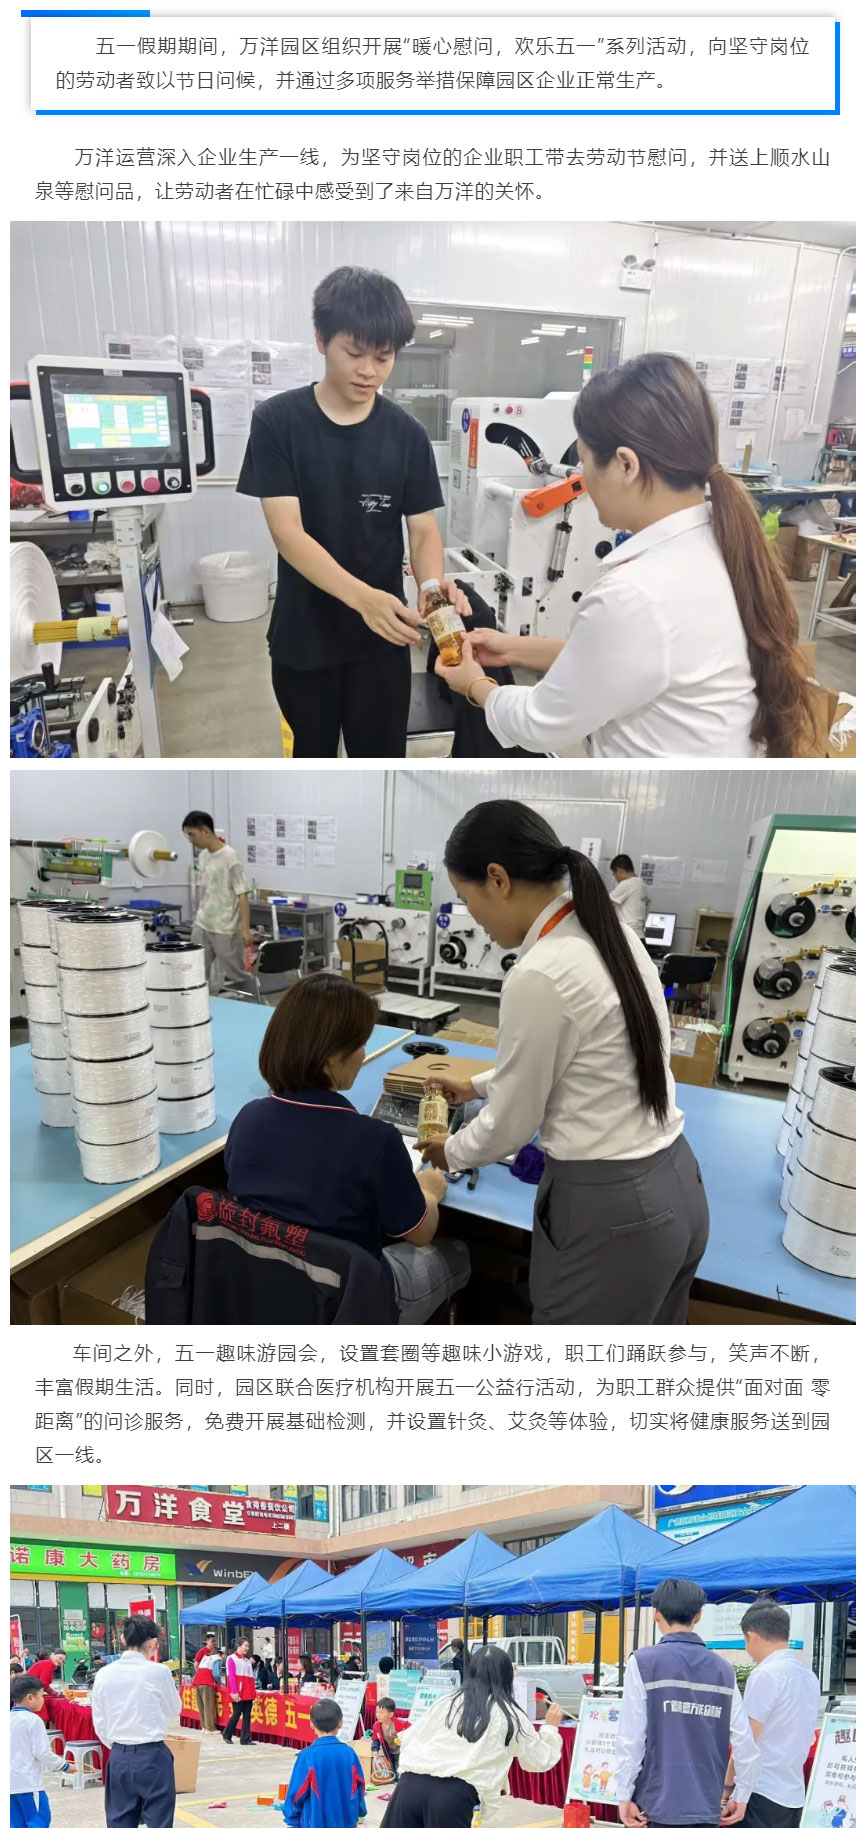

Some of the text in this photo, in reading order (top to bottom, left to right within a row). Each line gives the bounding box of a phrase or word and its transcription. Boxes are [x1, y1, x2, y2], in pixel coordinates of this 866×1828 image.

[115, 1489, 246, 1527] 万洋食堂
[10, 1546, 161, 1572] 诺康大药房
[834, 1728, 856, 1745] 趣
